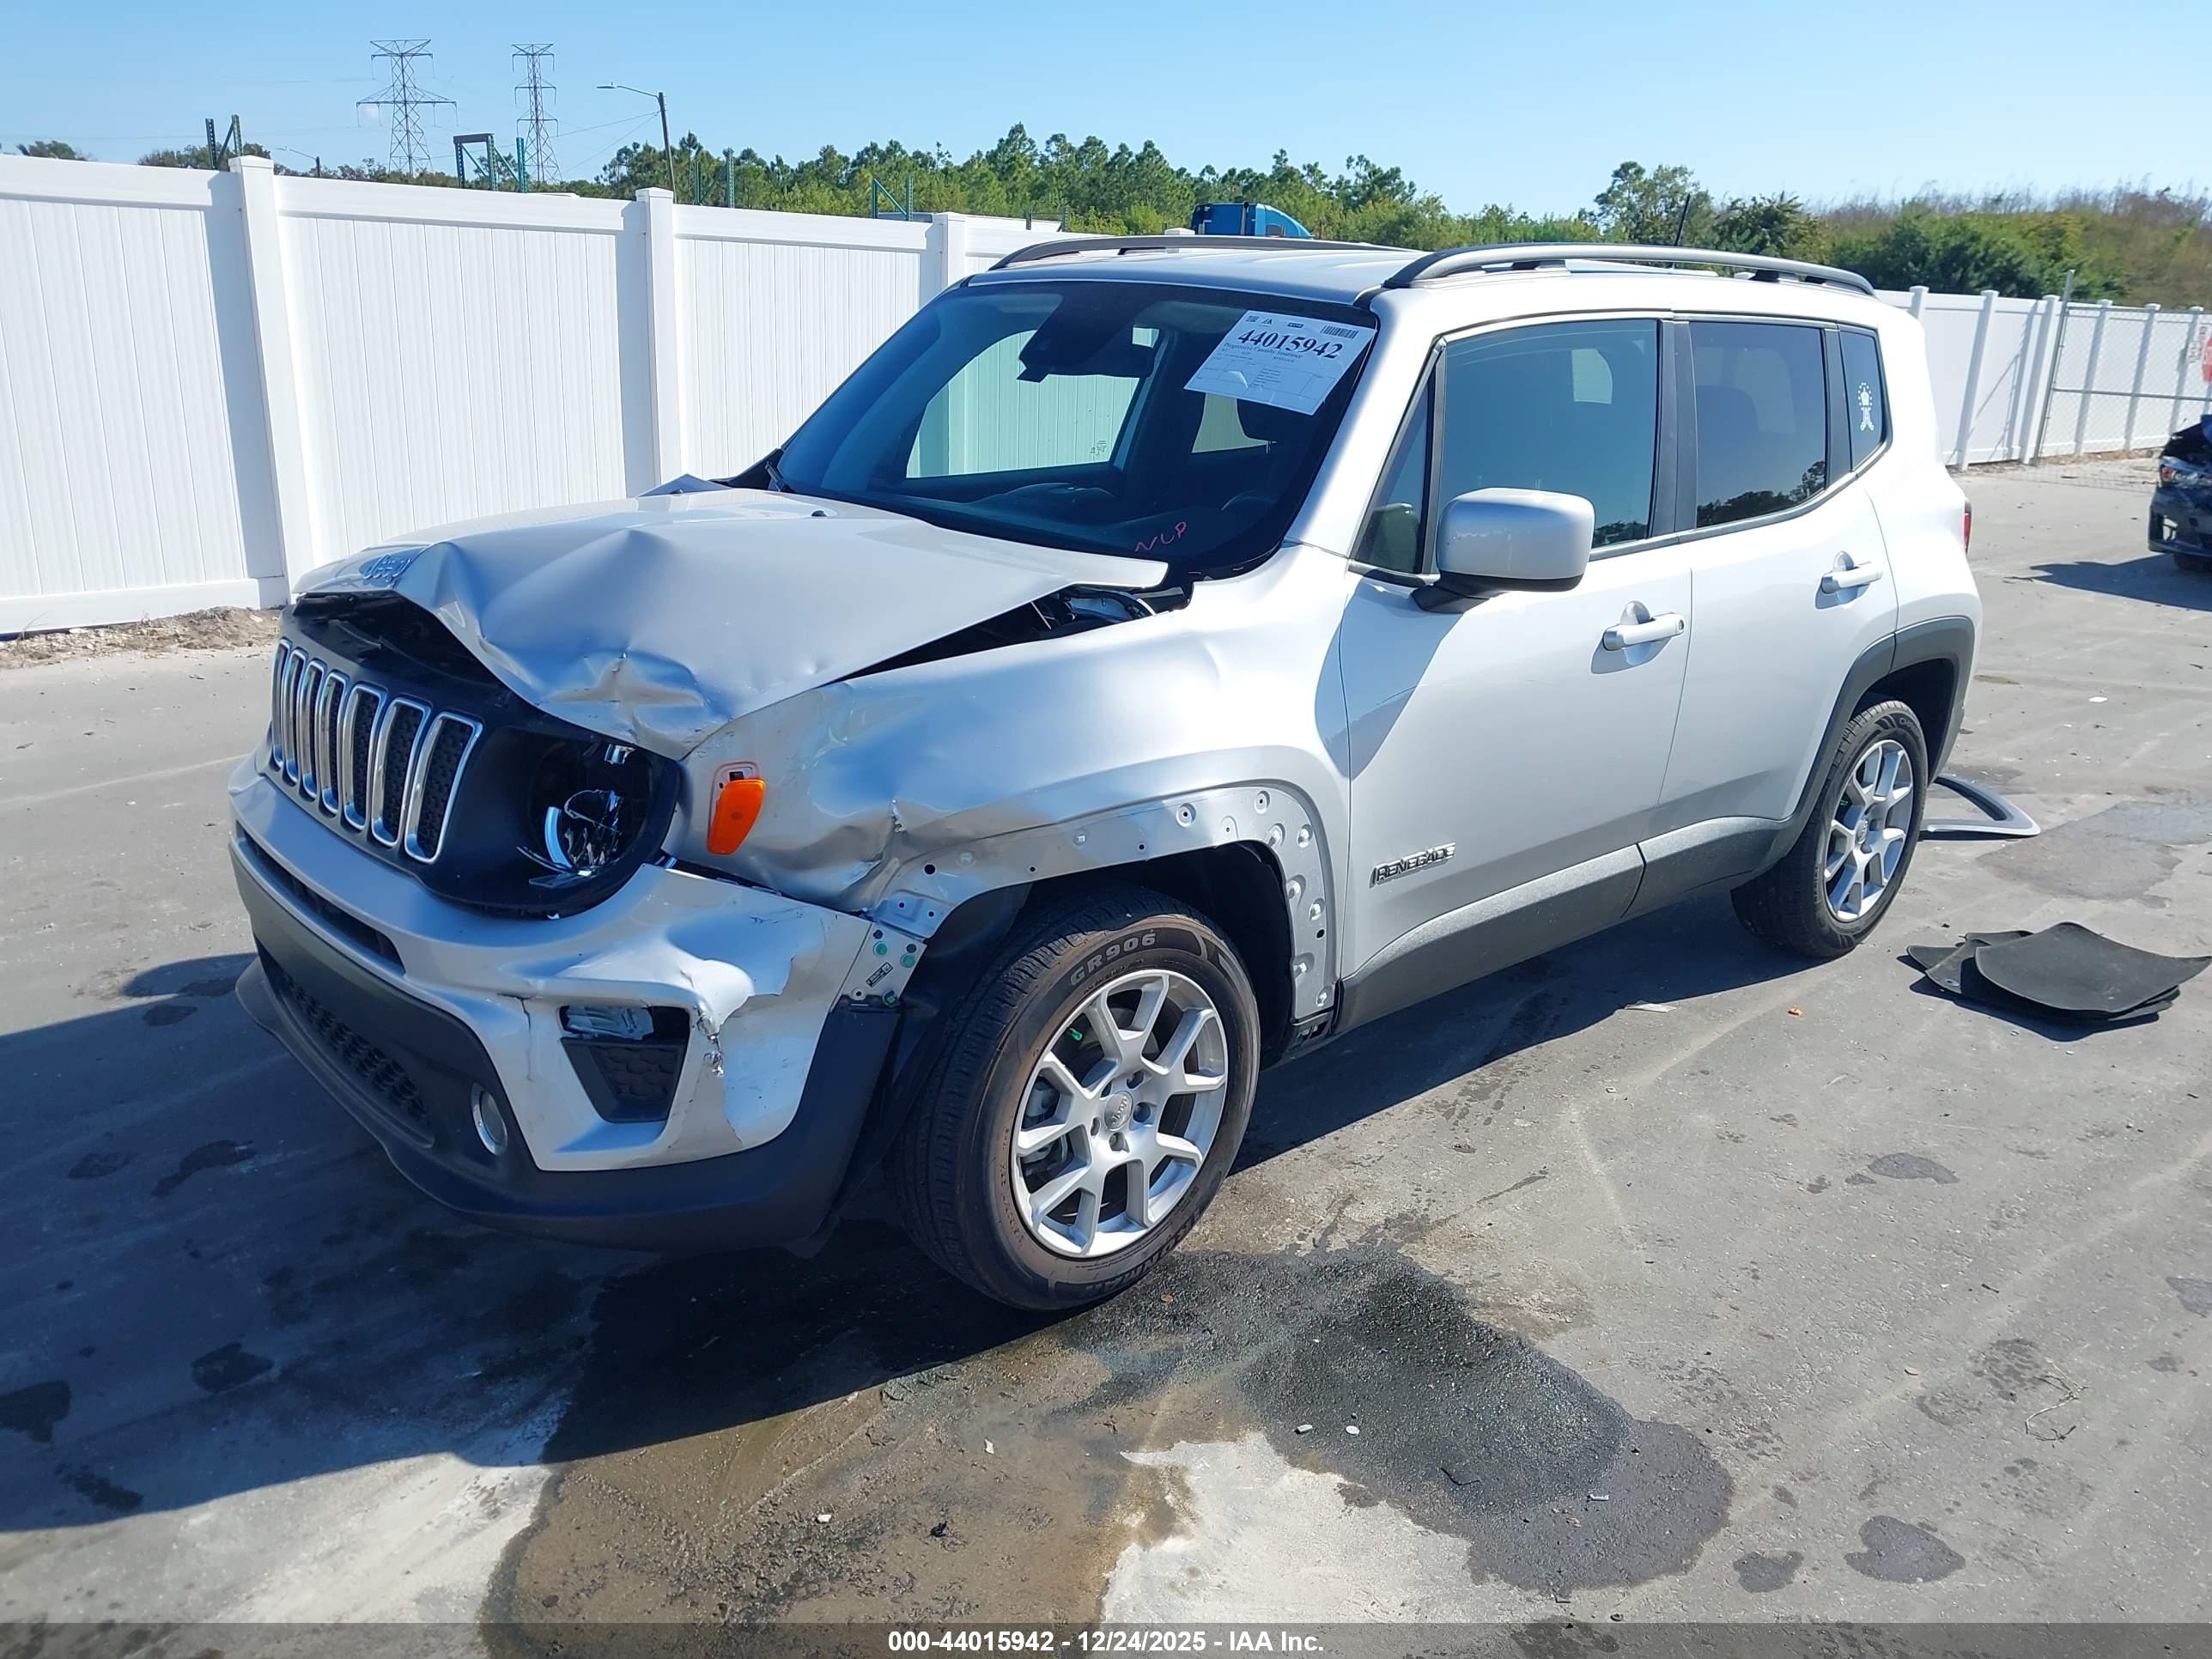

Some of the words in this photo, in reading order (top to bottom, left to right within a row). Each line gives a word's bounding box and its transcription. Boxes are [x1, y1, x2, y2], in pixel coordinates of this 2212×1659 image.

[1238, 329, 1344, 359] 44015942
[1376, 842, 1455, 883] RENEGADE
[1070, 932, 1157, 987] GR906
